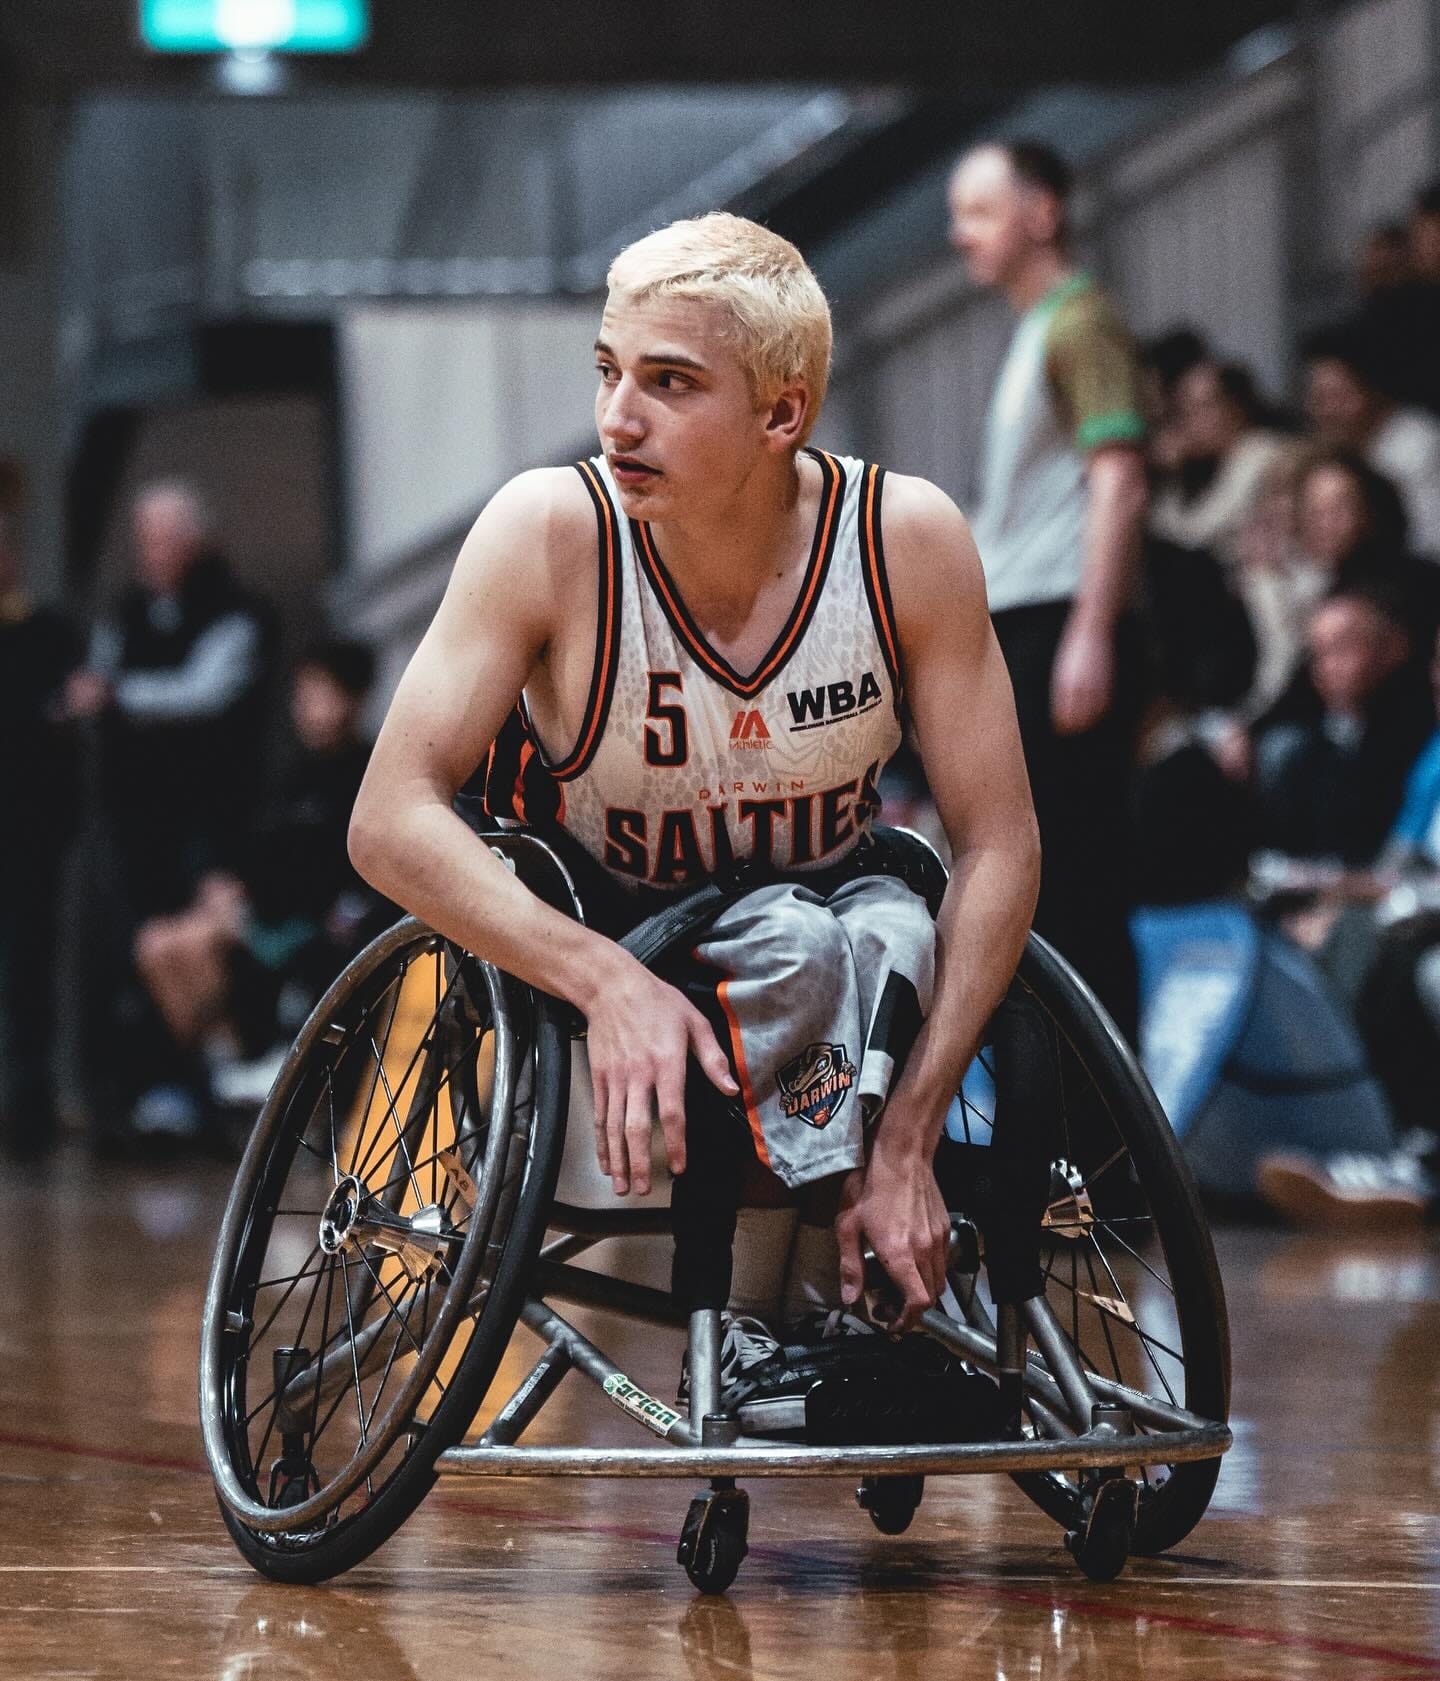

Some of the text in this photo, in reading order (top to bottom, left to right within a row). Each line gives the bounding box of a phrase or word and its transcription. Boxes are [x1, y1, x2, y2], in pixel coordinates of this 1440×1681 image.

[644, 672, 689, 768] 5
[787, 672, 882, 724] WBA
[698, 780, 804, 801] DARWIN
[786, 1071, 851, 1115] DARWIN
